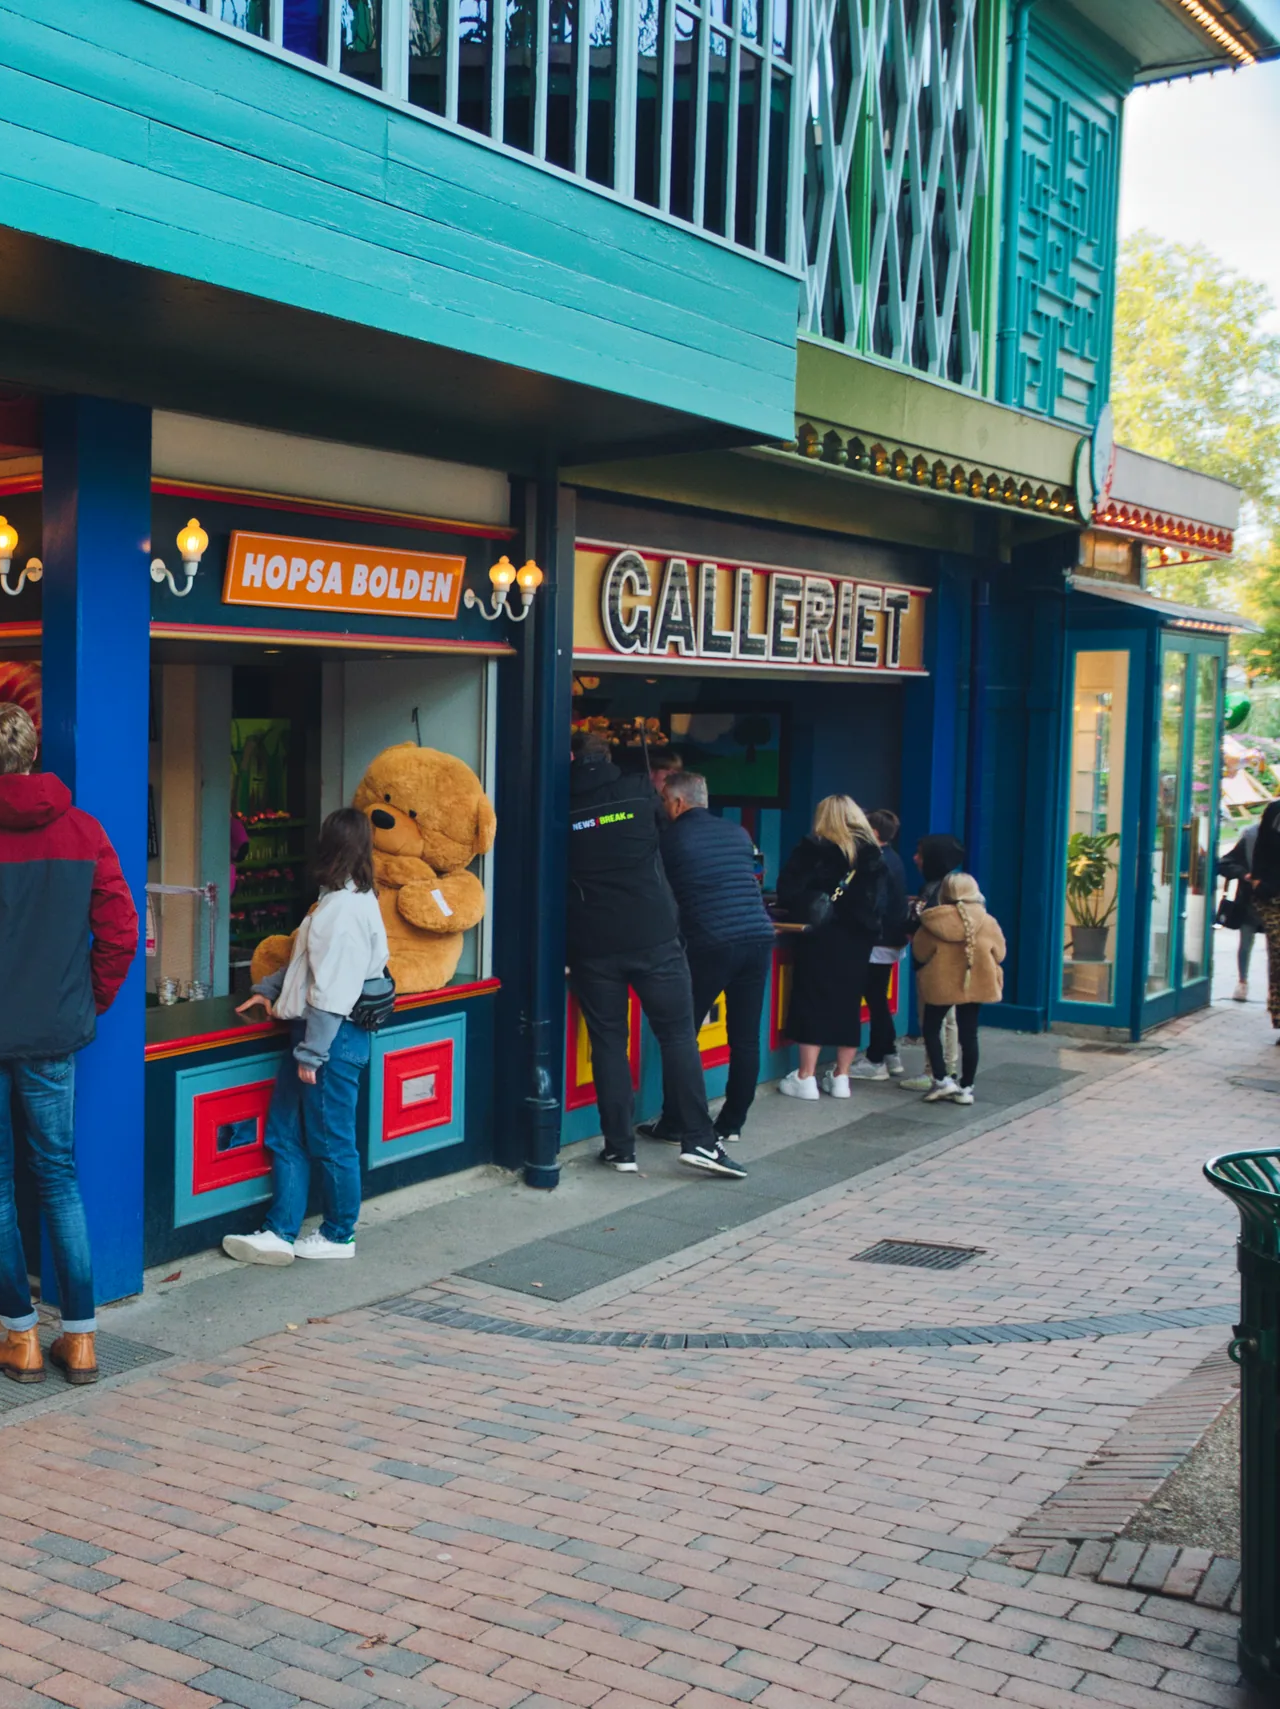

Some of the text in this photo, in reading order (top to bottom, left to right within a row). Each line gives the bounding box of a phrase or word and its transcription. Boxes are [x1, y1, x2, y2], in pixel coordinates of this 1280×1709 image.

[242, 553, 453, 603] HOPSA BOLDEN
[601, 550, 910, 669] GALLERIET
[572, 818, 596, 831] NEWS
